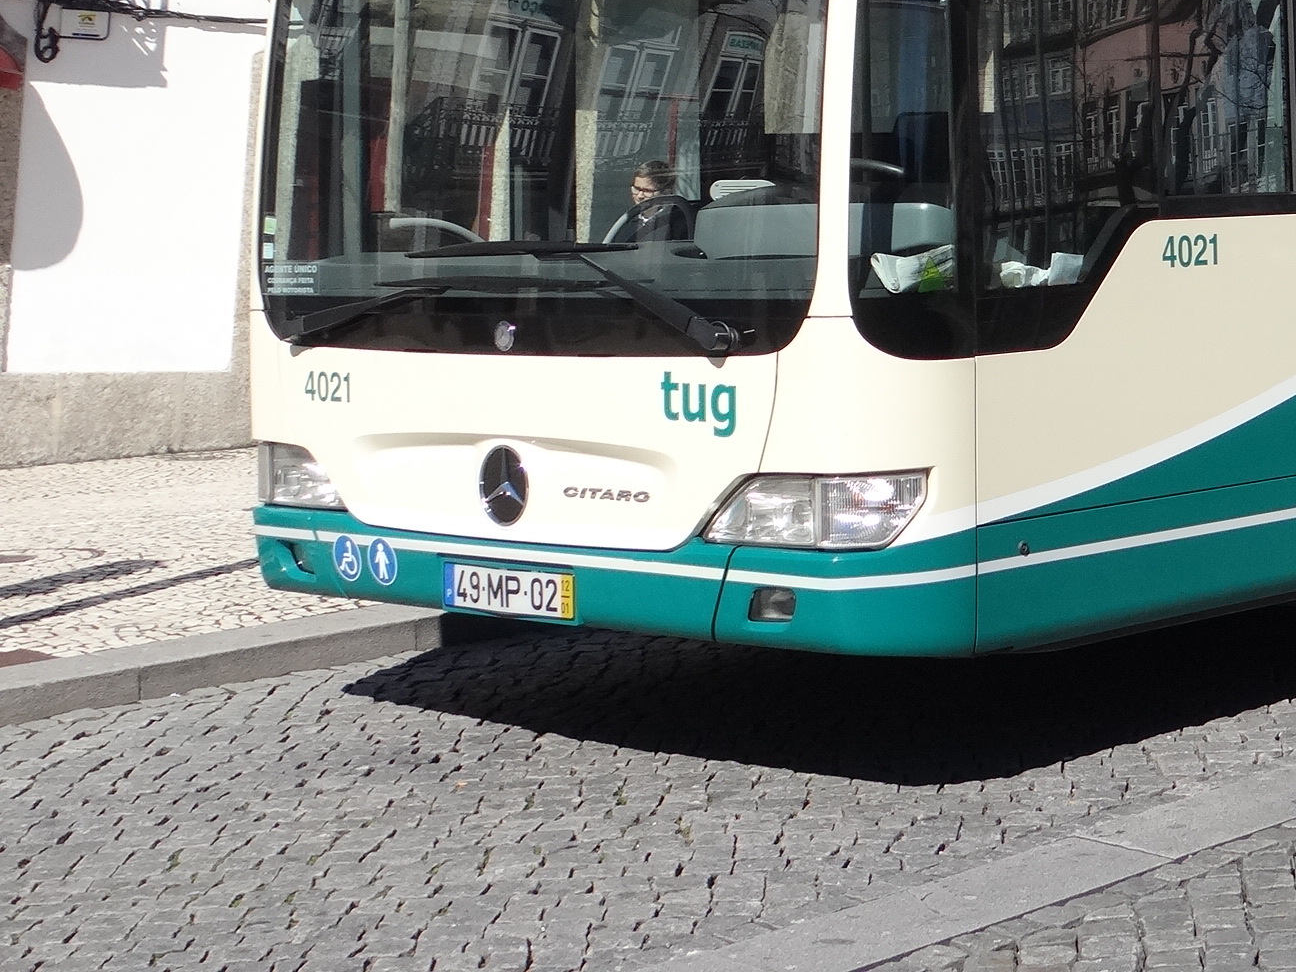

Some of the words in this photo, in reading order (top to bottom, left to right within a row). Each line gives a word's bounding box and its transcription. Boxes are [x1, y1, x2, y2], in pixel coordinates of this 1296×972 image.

[1162, 233, 1218, 268] 4021
[264, 265, 293, 274] AGENTE
[304, 370, 351, 403] 4021
[660, 371, 737, 438] tug
[563, 486, 651, 503] CITARO
